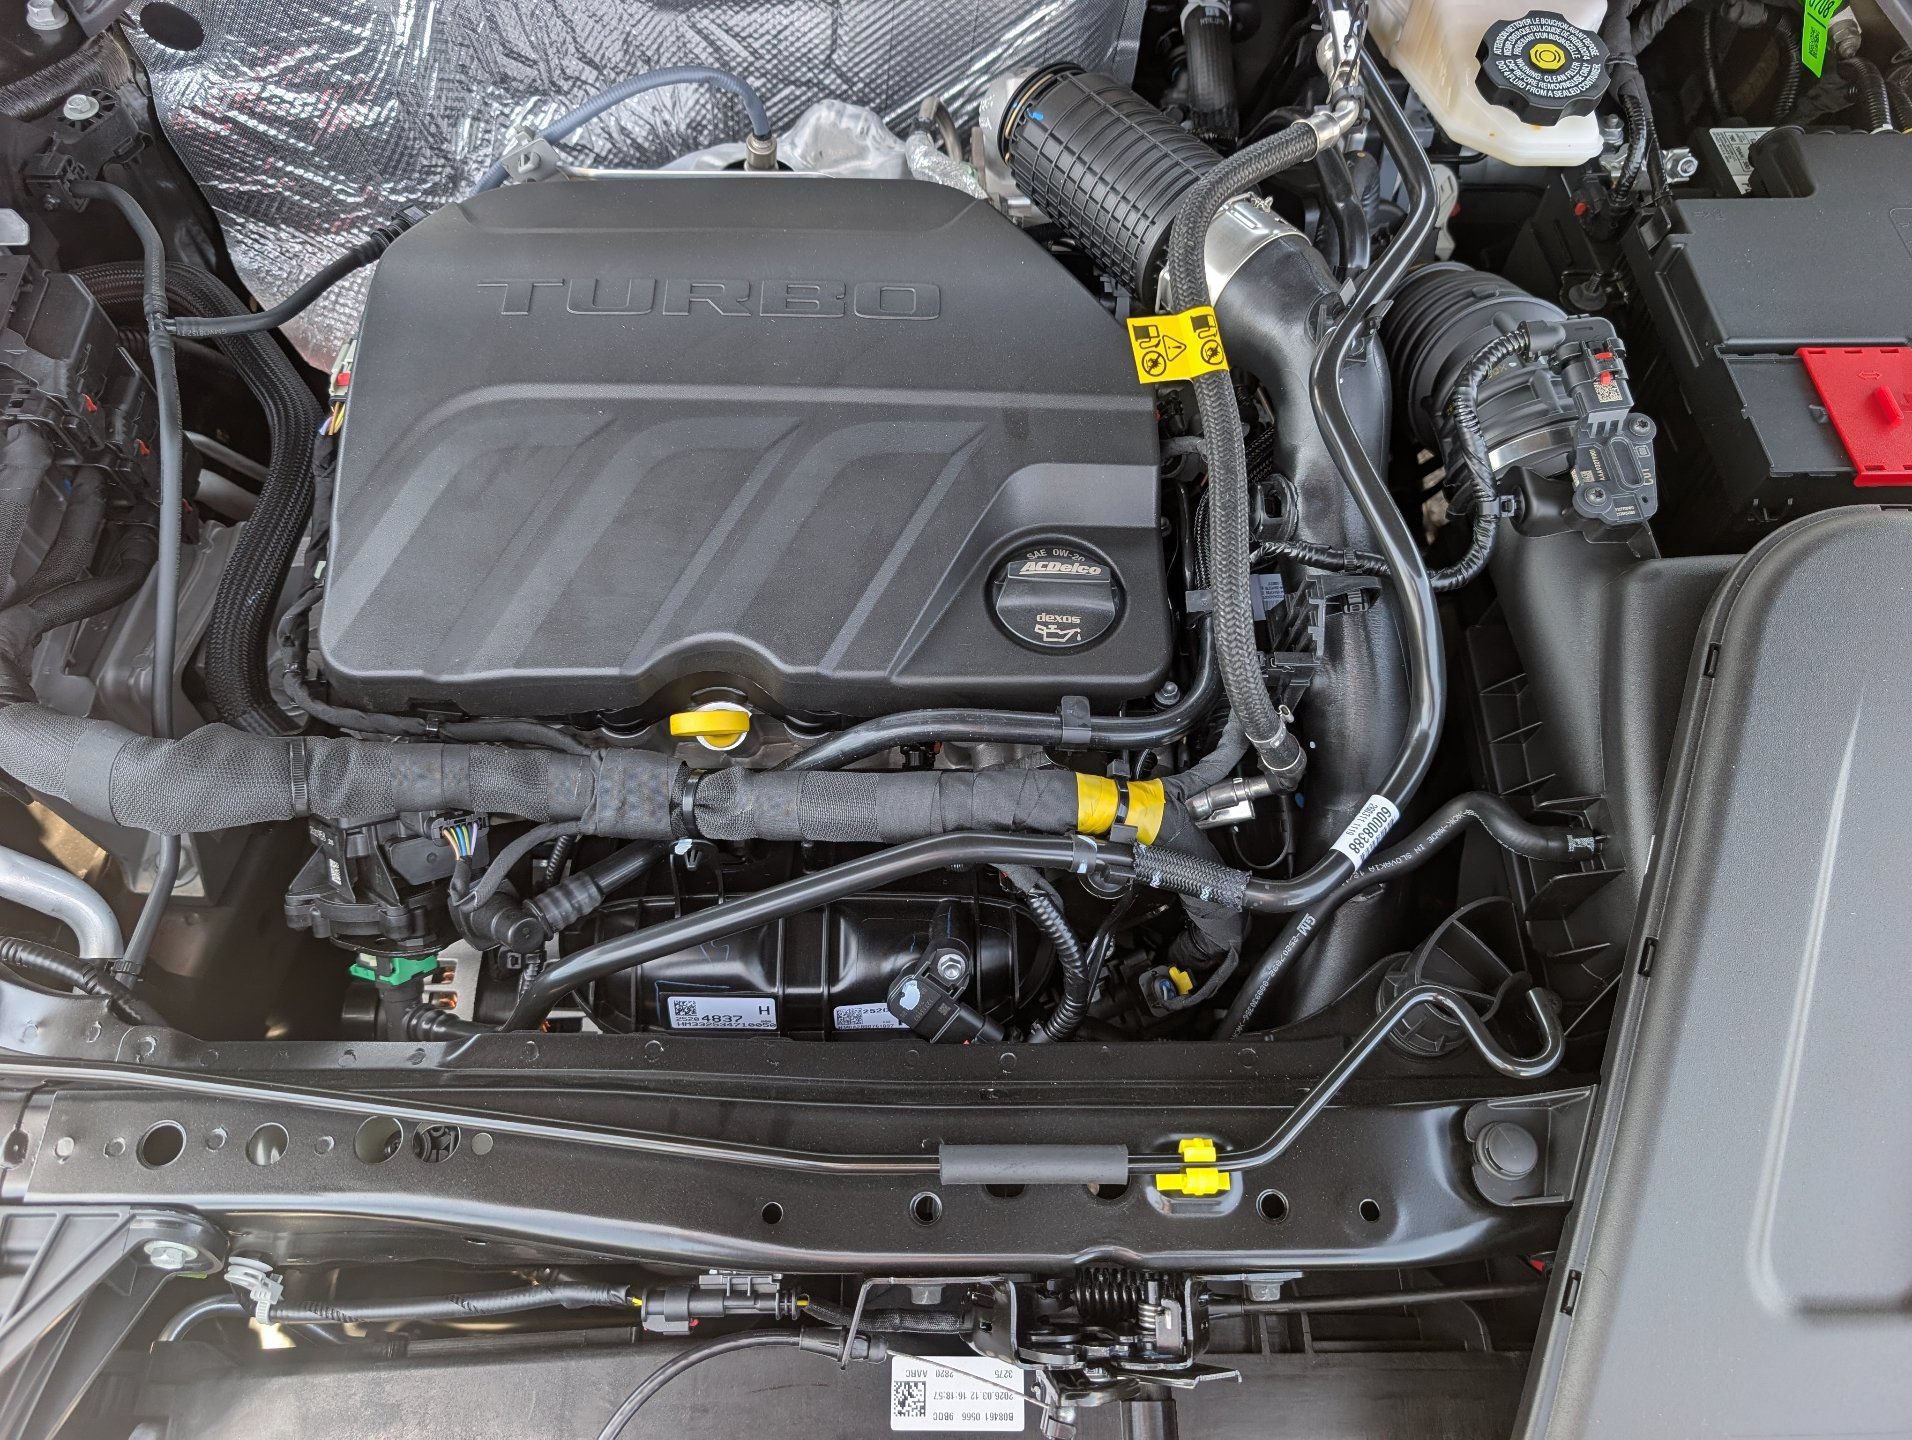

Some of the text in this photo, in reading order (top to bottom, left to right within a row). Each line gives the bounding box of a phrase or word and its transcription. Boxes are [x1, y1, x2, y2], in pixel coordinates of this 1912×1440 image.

[1531, 17, 1541, 25] LE
[1541, 18, 1569, 30] BOUCHON
[1561, 30, 1571, 38] DE
[1505, 59, 1519, 73] CAP
[1515, 70, 1539, 87] BEFORE
[1515, 57, 1581, 83] WARNING: CLEAN FILLER
[1507, 73, 1528, 89] FLUID
[1525, 86, 1548, 96] FROM
[1553, 86, 1581, 98] SEALED
[477, 278, 941, 320] TURBO
[1026, 548, 1085, 562] SAE 0W-20
[1019, 561, 1102, 575] ACDelco
[1036, 612, 1082, 624] dexos
[1348, 806, 1392, 854] 60008388
[1367, 851, 1413, 873] SLOVAKIA
[1296, 912, 1316, 936] GM
[758, 1005, 770, 1016] H
[905, 1369, 928, 1378] AARC
[994, 1369, 1013, 1379] 3275
[933, 1391, 1014, 1400] 2026.03.12 16:18:57
